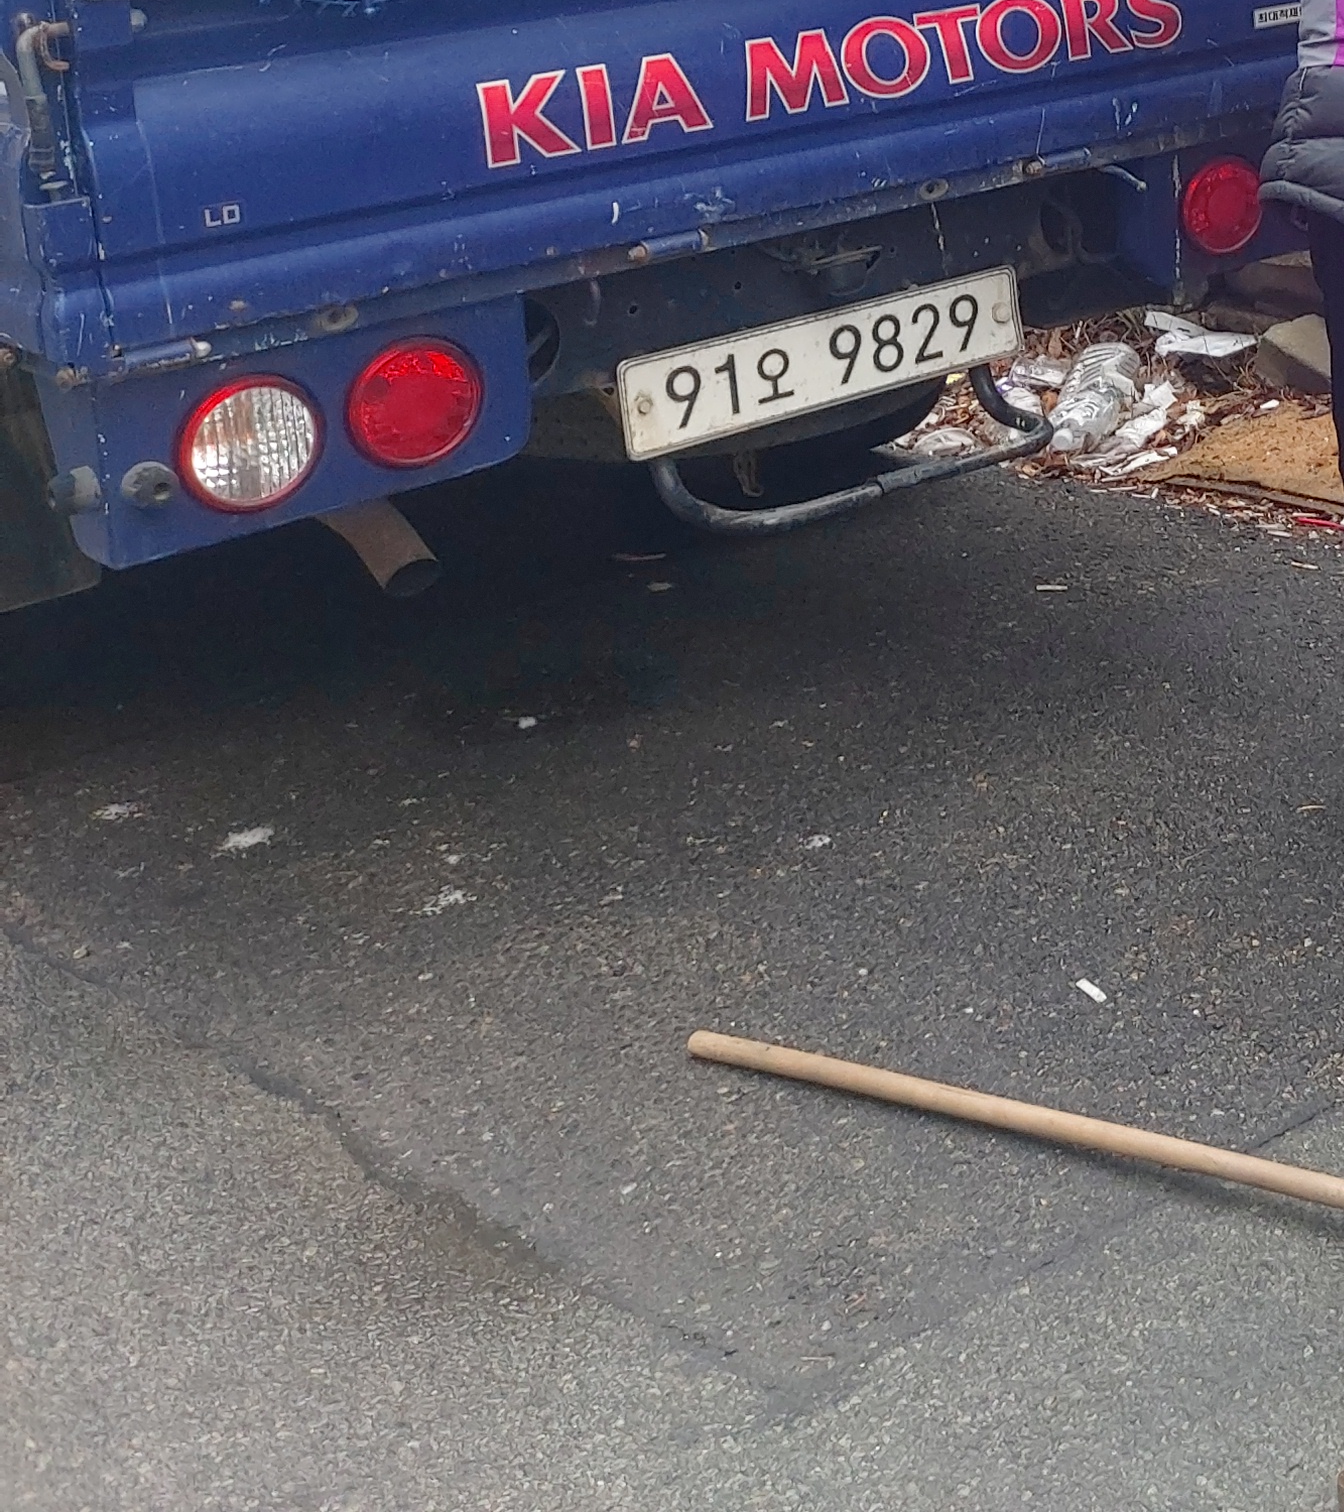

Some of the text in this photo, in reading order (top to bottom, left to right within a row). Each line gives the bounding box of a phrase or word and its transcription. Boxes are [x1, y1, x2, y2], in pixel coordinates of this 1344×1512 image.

[1258, 6, 1302, 23] 최대적재
[476, 53, 713, 169] KIA
[666, 294, 979, 430] 91오 9829
